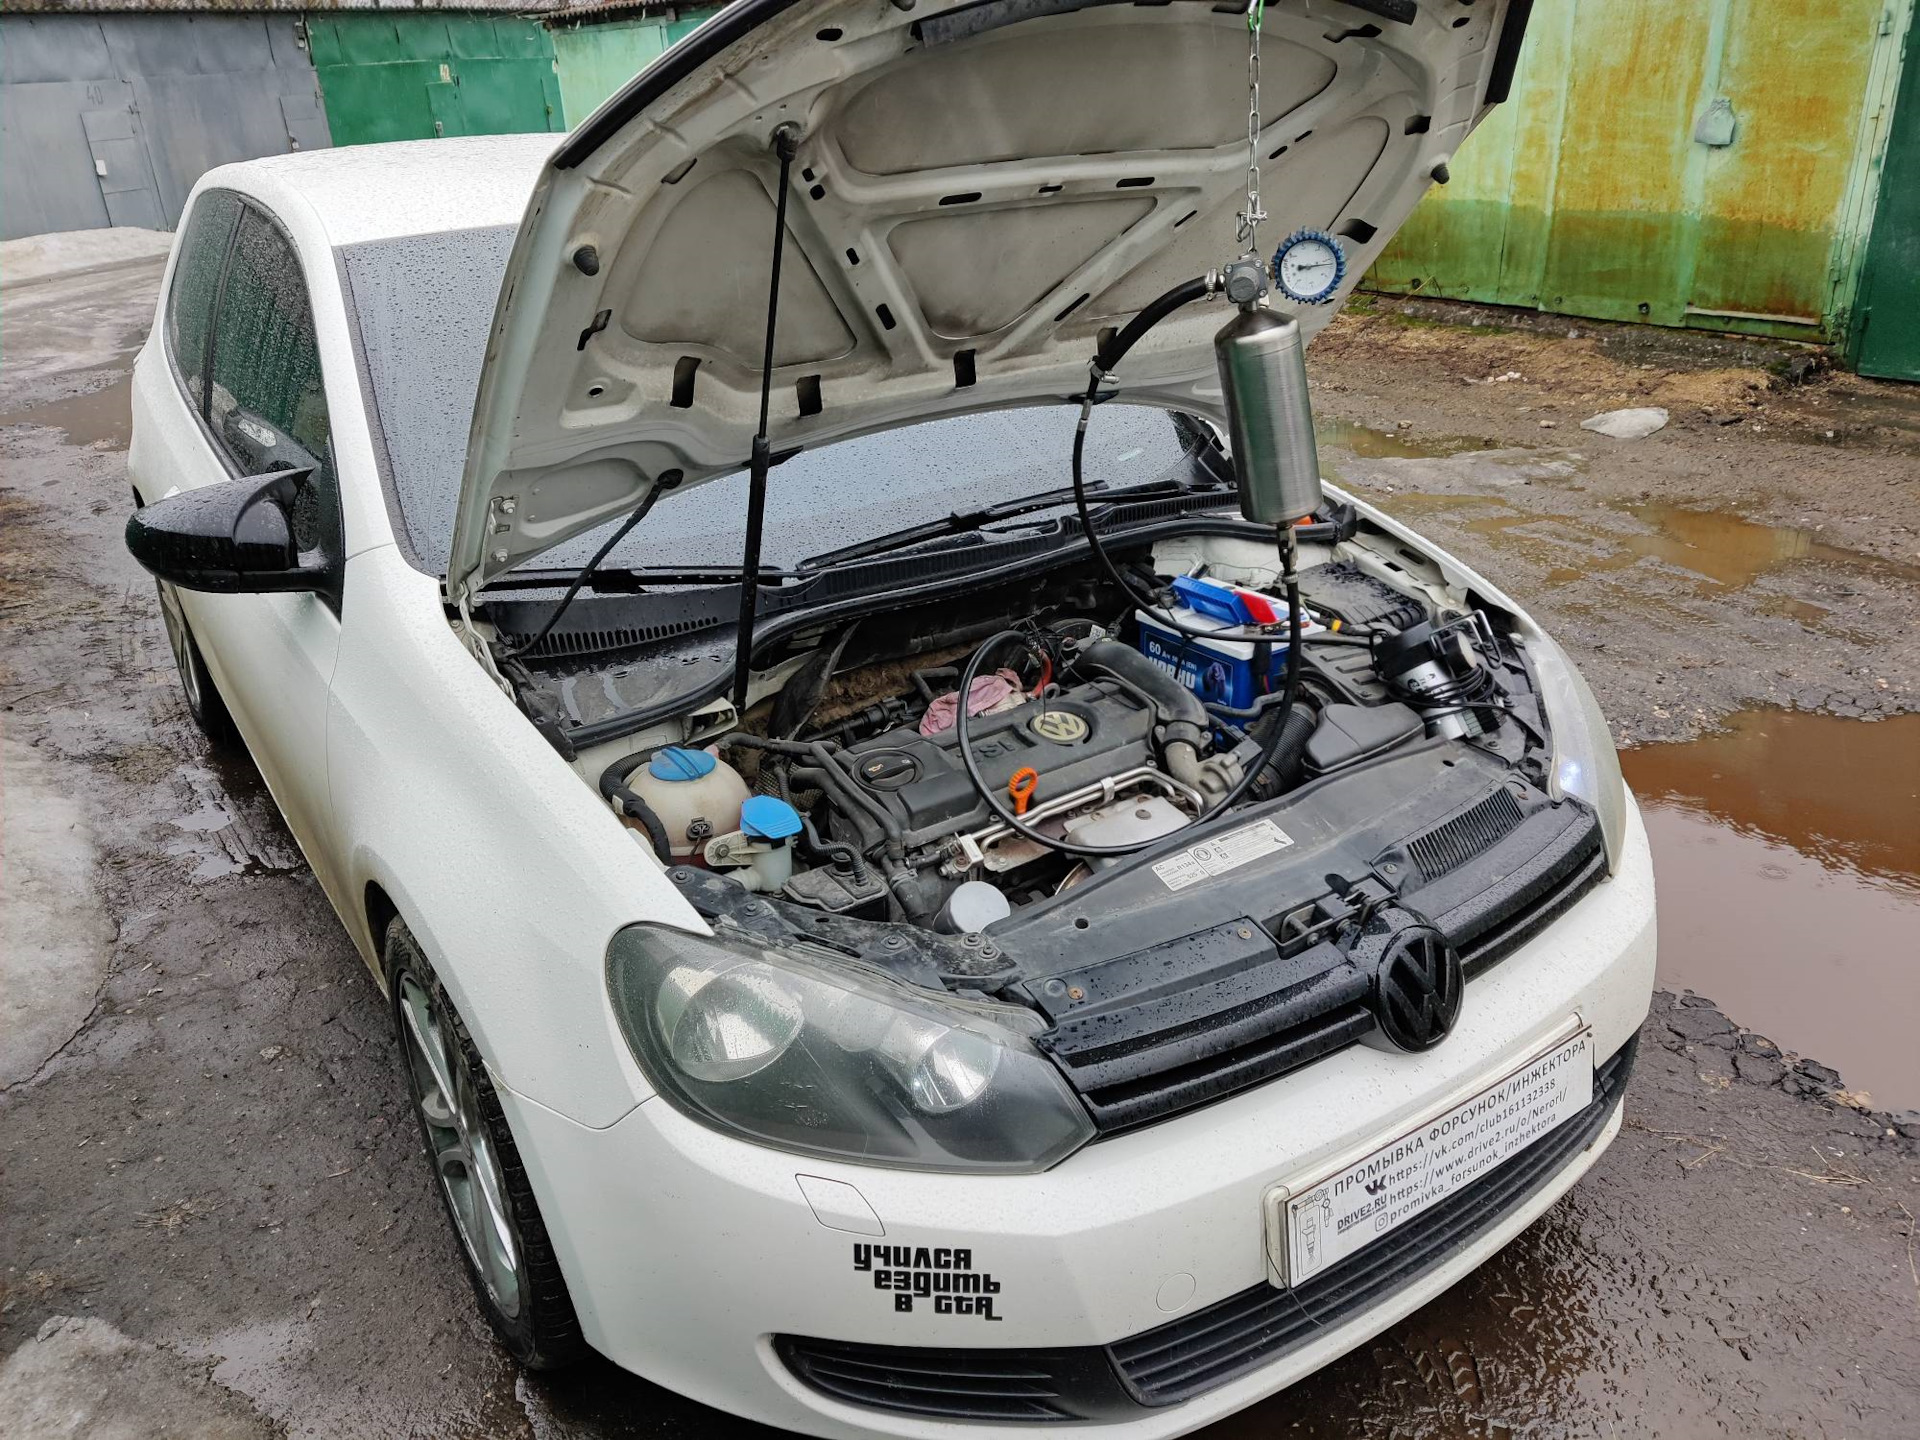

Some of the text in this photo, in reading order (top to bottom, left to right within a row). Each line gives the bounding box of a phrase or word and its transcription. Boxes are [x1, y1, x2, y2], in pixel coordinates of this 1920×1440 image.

[1149, 641, 1162, 655] 60
[1335, 1039, 1586, 1196] ПРОМЫВКА ФОРСУНОК/ИНЖЕКТОРА
[1389, 1078, 1556, 1185] https://vk.com/club161132338
[1391, 1113, 1556, 1224] promivka_forsunok_inzhektora
[1337, 1194, 1387, 1231] DRIVE2.RU
